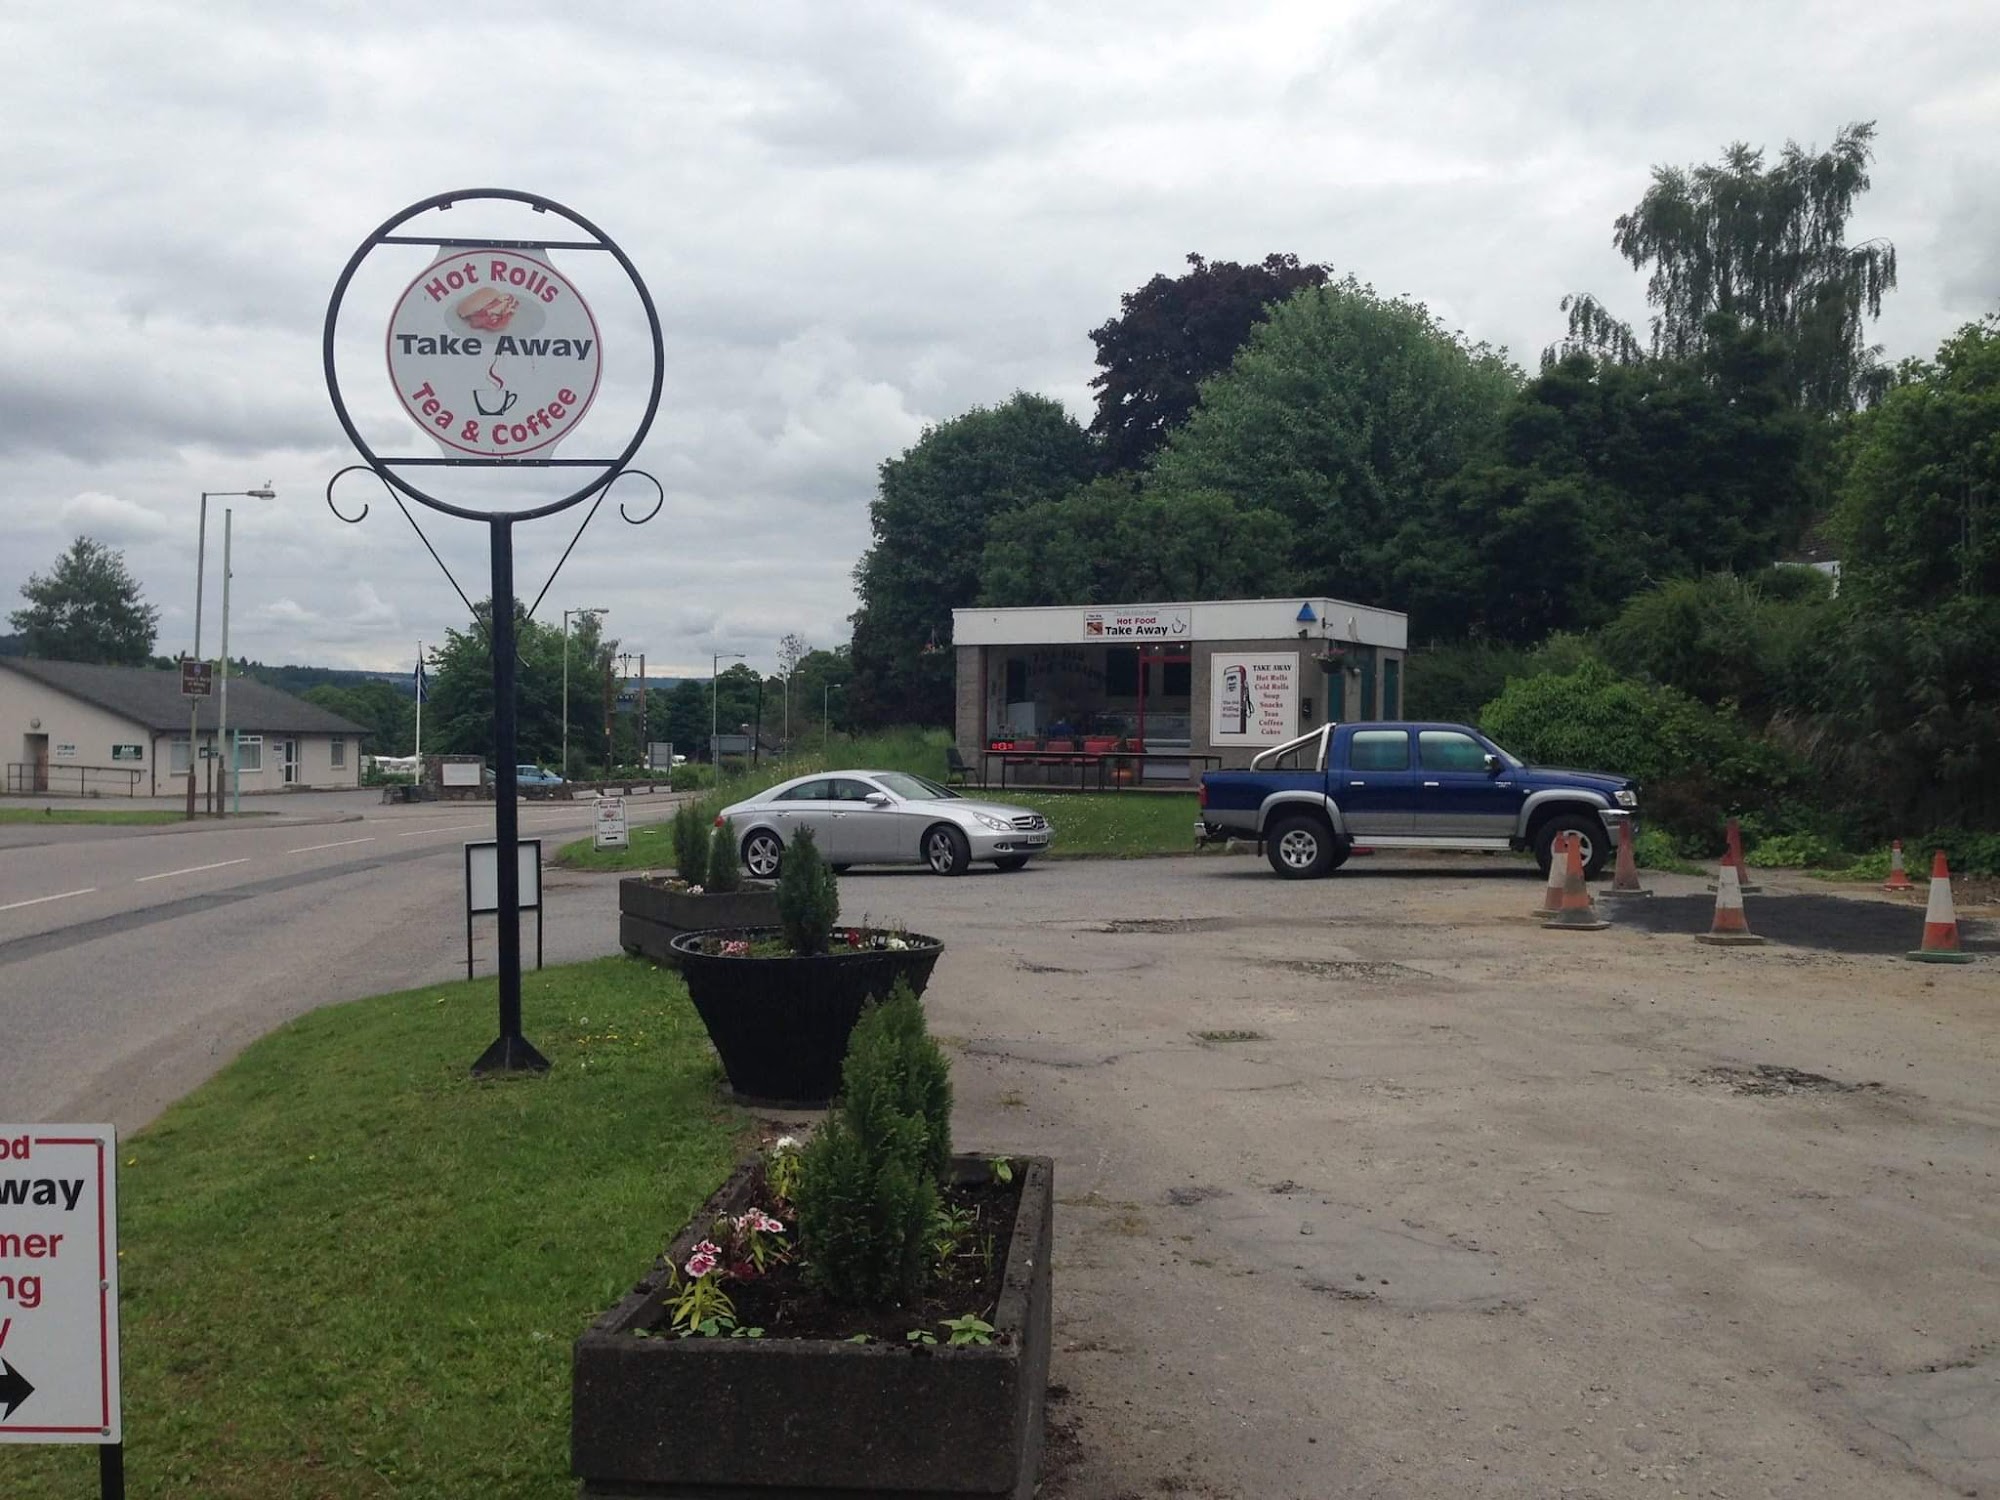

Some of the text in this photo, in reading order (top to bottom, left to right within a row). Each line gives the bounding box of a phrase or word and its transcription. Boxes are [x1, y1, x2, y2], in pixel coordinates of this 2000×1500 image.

[424, 260, 559, 303] Hot Rolls
[396, 334, 593, 361] Take Away
[412, 382, 577, 445] Tea & Coffee
[1105, 625, 1168, 636] Take Away
[0, 1178, 84, 1211] way
